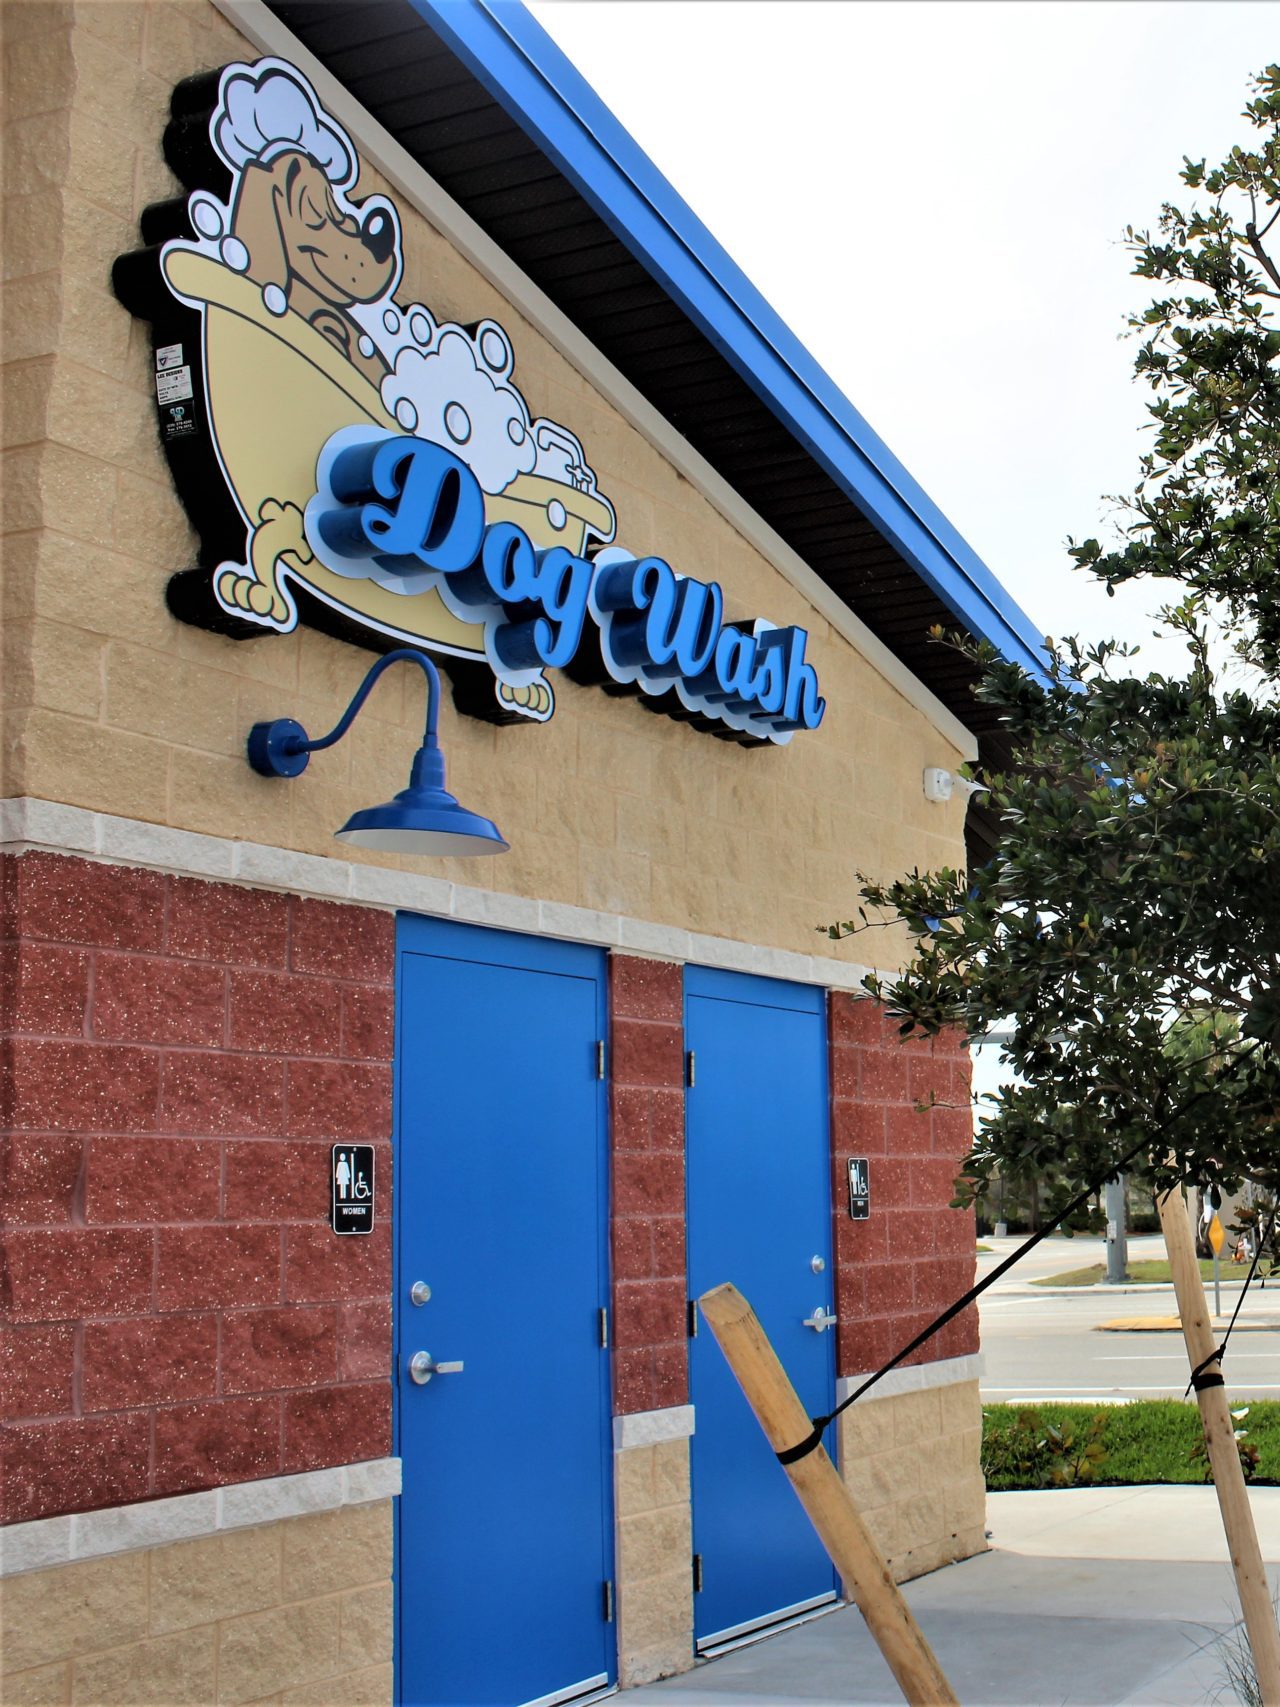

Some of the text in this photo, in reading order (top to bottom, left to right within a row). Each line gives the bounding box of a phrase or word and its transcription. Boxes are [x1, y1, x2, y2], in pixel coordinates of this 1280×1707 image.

[361, 436, 826, 729] Dog Wash
[343, 1207, 366, 1215] WOMEN
